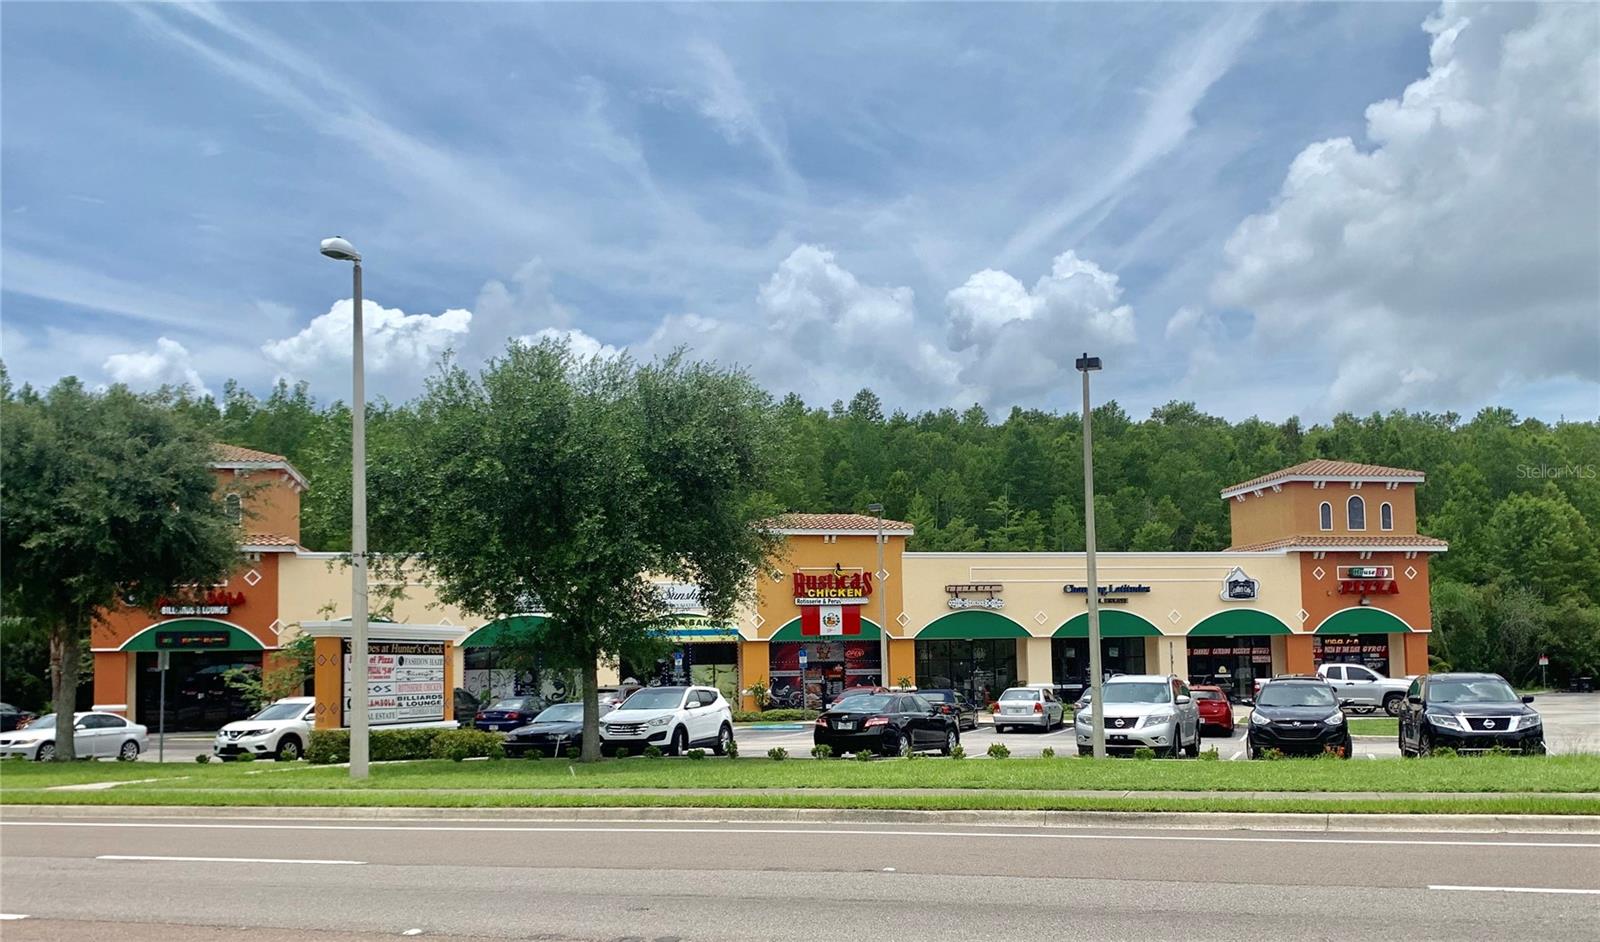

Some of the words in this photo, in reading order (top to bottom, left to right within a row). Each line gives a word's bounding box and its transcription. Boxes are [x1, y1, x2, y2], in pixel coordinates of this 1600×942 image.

[1340, 581, 1400, 595] PIZZA
[807, 588, 863, 598] CHICKEN
[202, 606, 229, 615] LOUNGE
[382, 645, 390, 653] at
[391, 643, 421, 654] Hunter's
[422, 643, 444, 654] Creek
[1362, 645, 1387, 653] GYROS
[378, 656, 394, 664] Pizza
